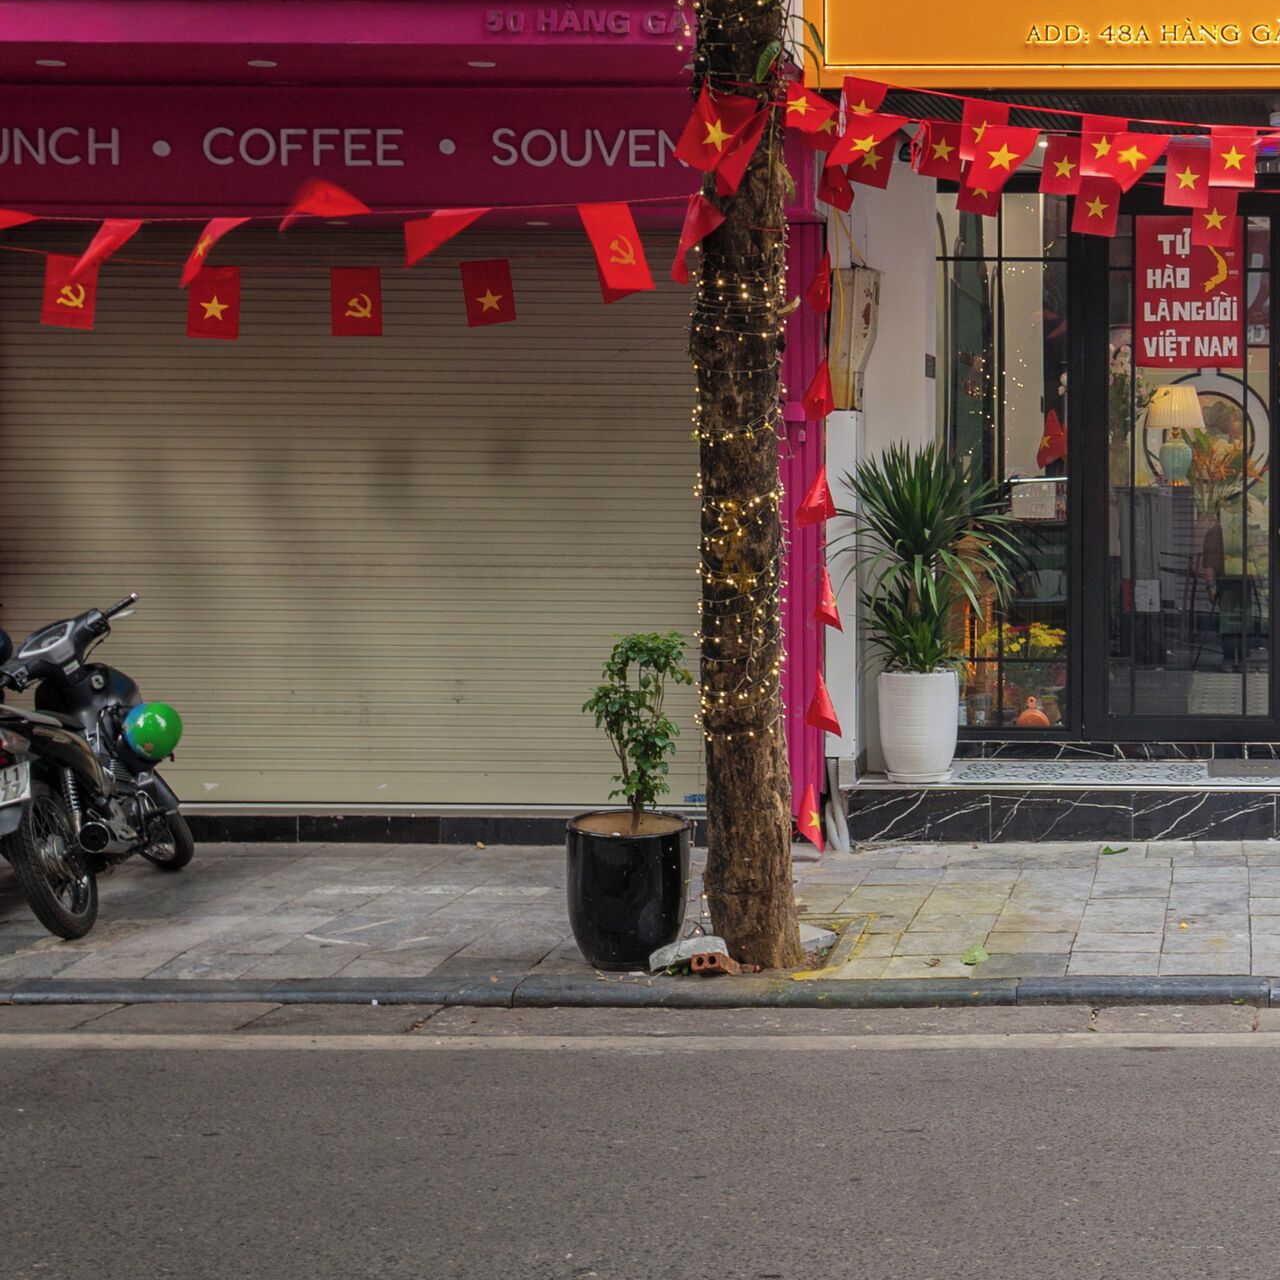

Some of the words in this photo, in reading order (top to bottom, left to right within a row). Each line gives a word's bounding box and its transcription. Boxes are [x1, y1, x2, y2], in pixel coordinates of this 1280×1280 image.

[485, 9, 526, 33] 50
[536, 0, 631, 34] HÀNG
[1025, 23, 1090, 44] ADD:
[1098, 23, 1152, 44] 48A
[1160, 17, 1243, 45] HÀNG
[202, 126, 405, 167] COFFEE
[1157, 227, 1192, 259] TỰ
[1146, 263, 1191, 289] HÀO
[1143, 298, 1171, 322] LÀ
[1194, 336, 1238, 357] NAM
